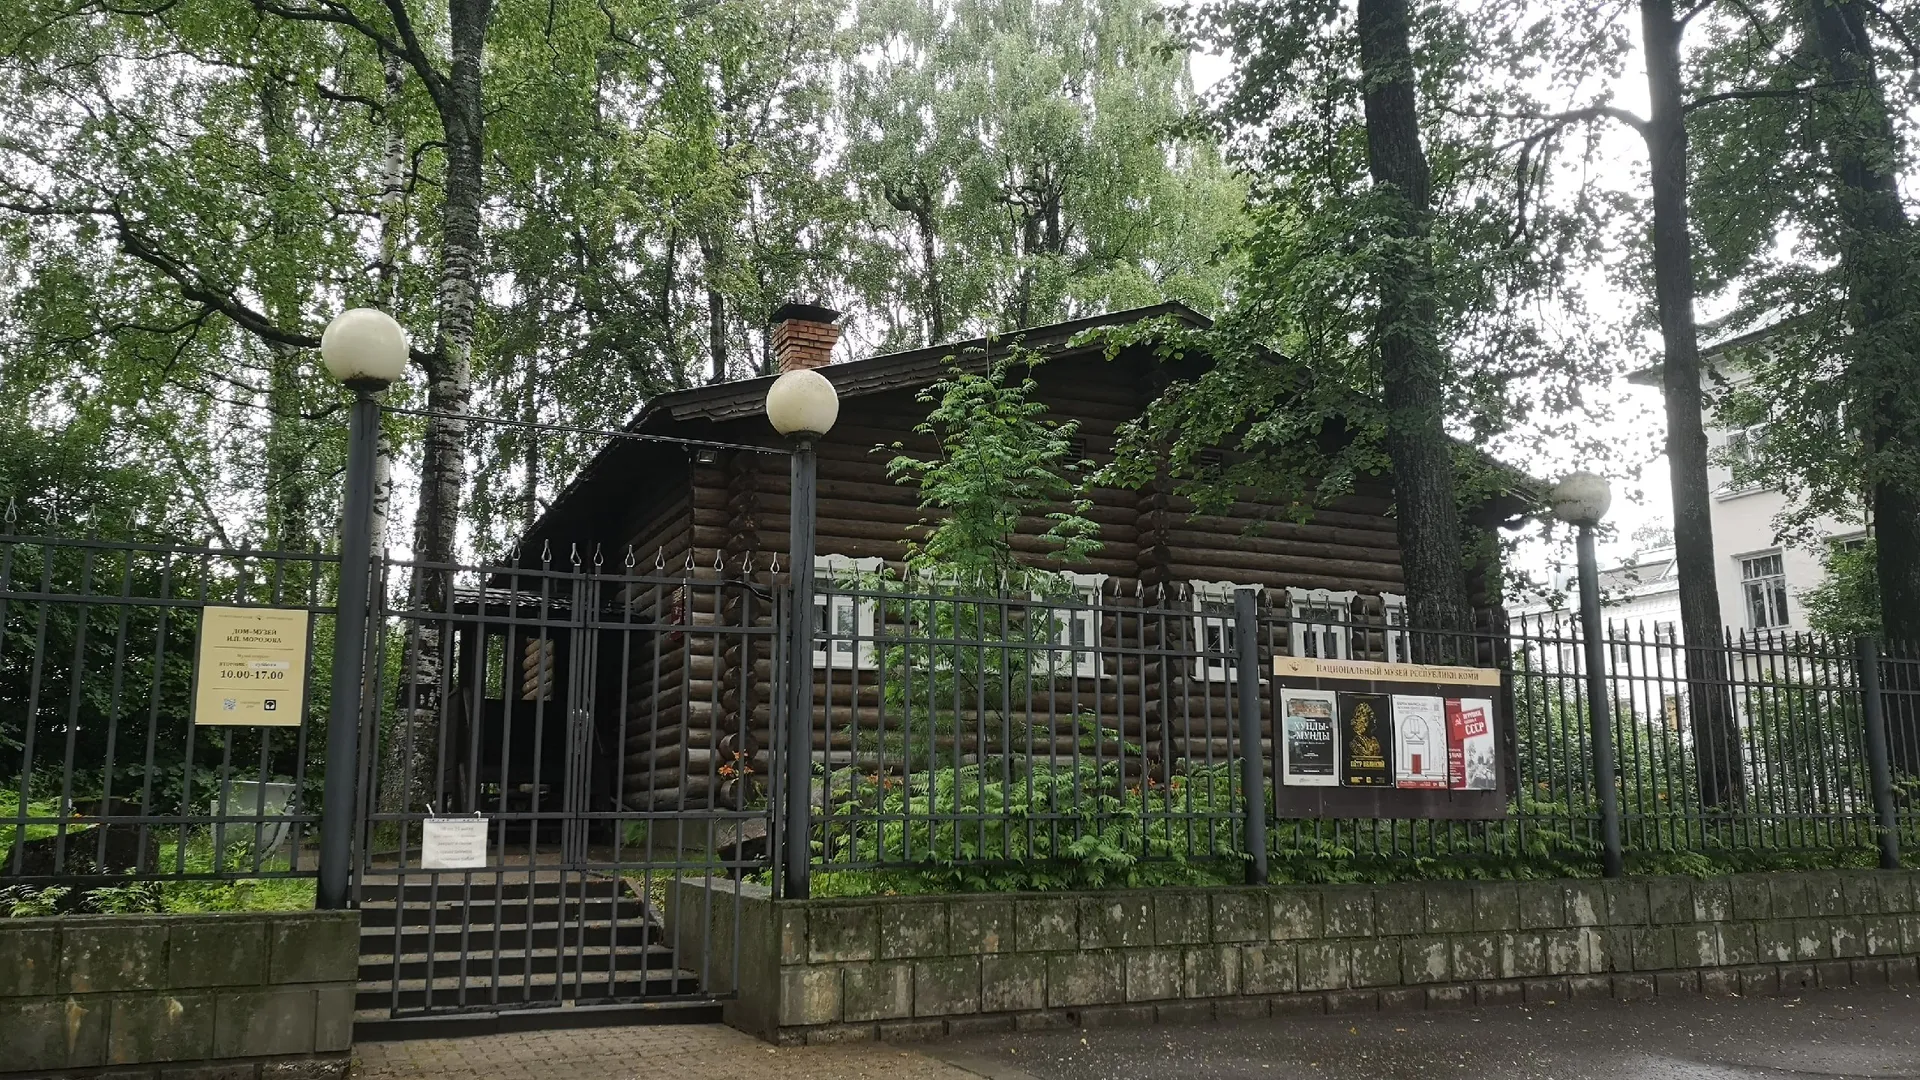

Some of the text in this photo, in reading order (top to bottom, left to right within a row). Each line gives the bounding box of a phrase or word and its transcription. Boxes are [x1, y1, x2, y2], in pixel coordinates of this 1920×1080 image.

[231, 628, 277, 636] ДОМ-МУЗЕЙ
[220, 669, 284, 680] 10.00-17.00
[1316, 664, 1479, 681] НАЦИОНАЛЬНЫЙ МУЗЕЙ РЕСПУБЛИКИ КОМИ
[1465, 722, 1485, 736] СССР
